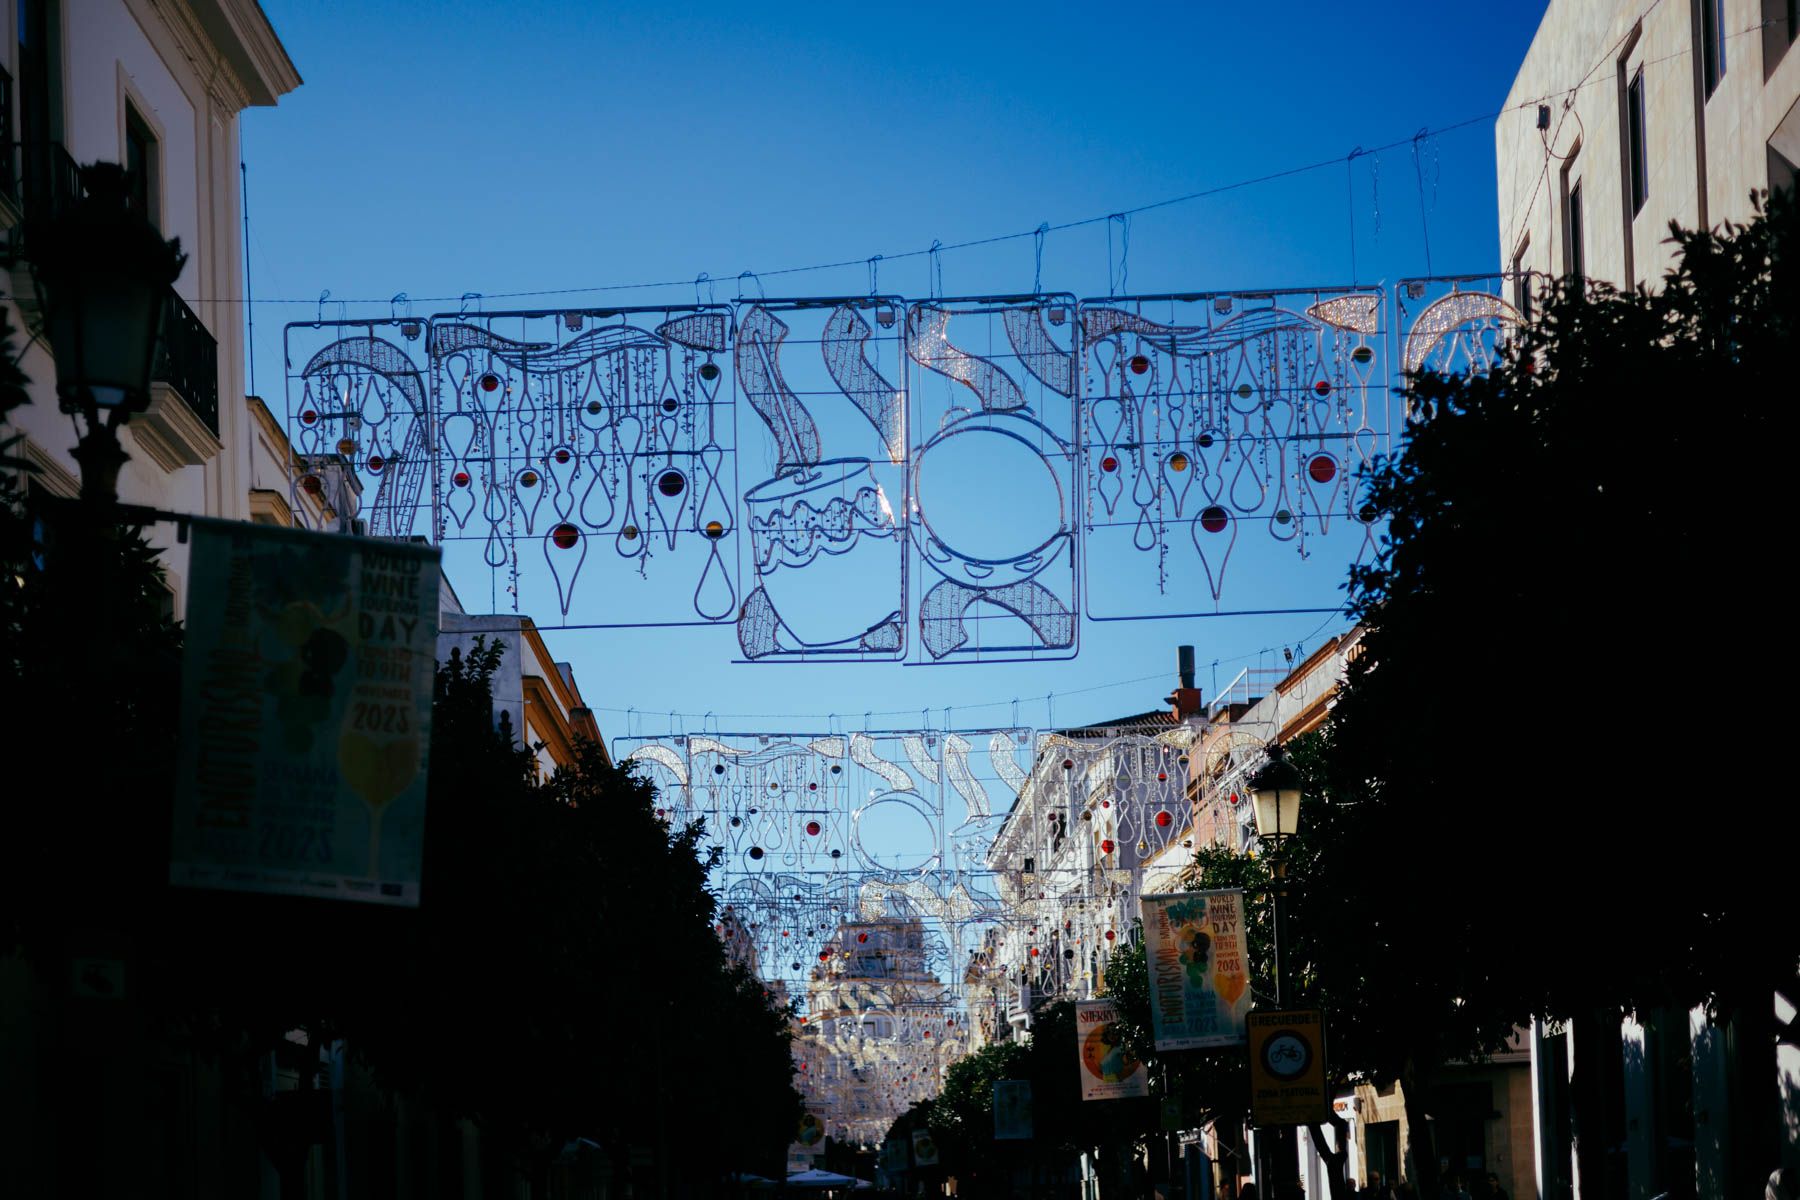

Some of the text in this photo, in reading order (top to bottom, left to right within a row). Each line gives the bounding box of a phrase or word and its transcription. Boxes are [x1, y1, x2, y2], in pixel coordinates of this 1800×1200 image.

[361, 550, 421, 575] WORLD
[361, 570, 420, 600] WINE
[359, 612, 418, 645] DAY
[353, 701, 410, 733] 2025
[1209, 895, 1234, 904] WORLD
[1210, 903, 1236, 914] WINE
[1212, 920, 1238, 934] DAY
[1216, 959, 1240, 973] 2025
